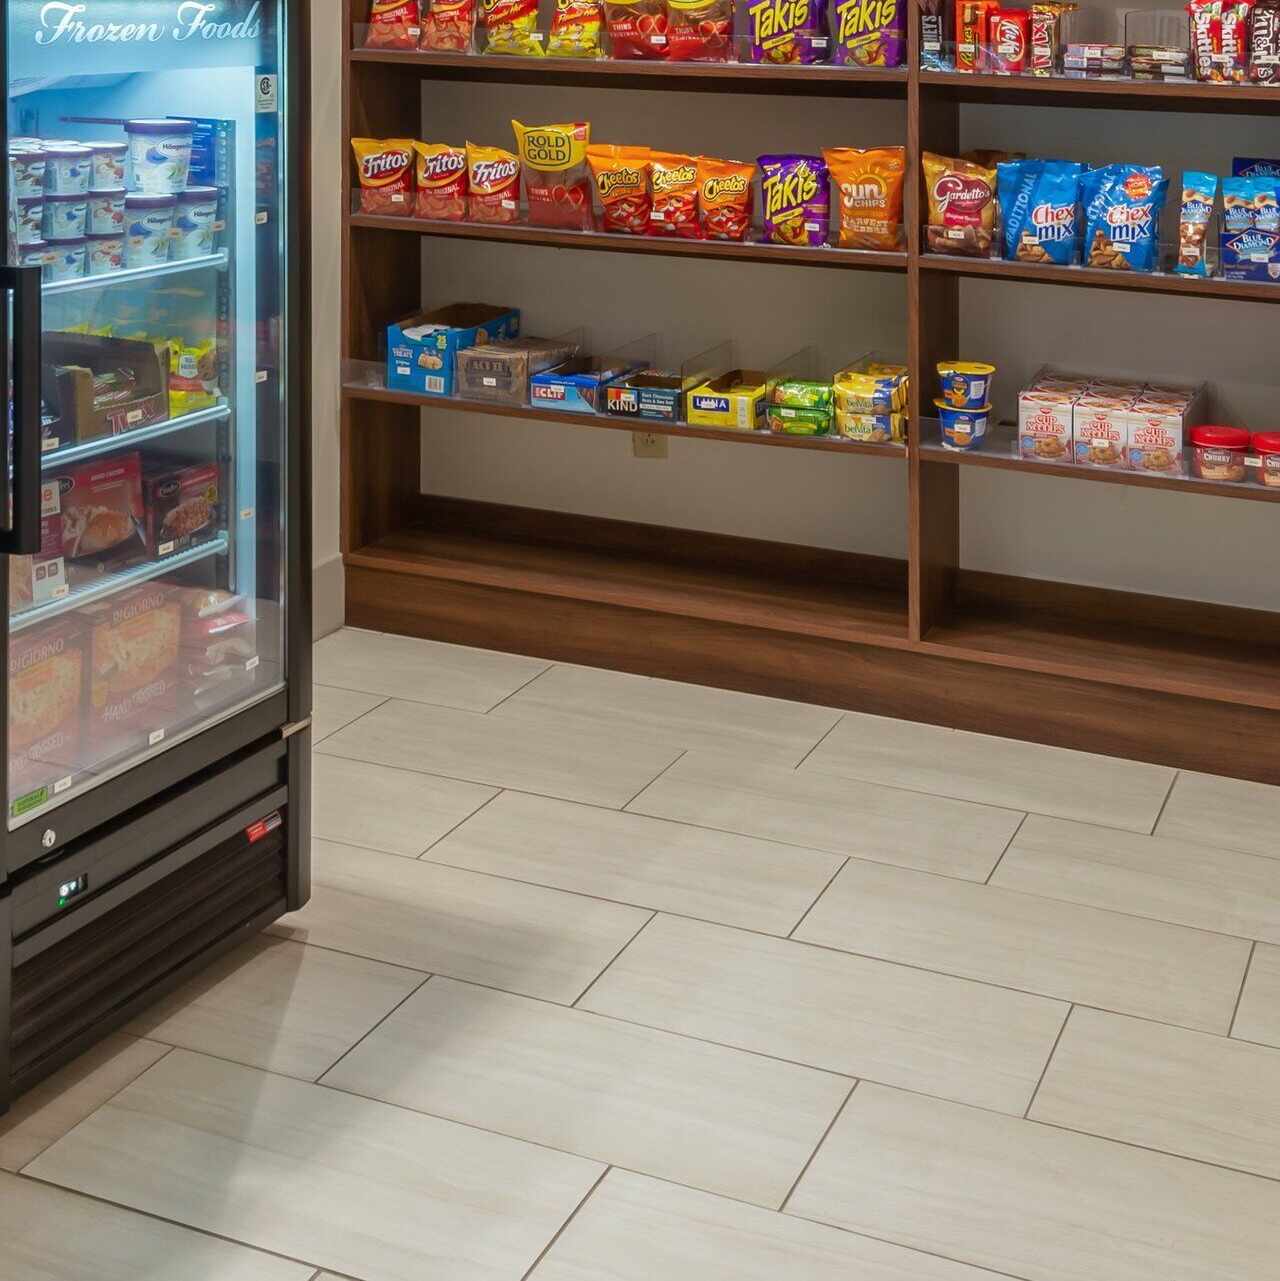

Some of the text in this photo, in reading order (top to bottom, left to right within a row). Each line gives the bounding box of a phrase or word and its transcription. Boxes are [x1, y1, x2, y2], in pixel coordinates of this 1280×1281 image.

[35, 1, 261, 46] Frozen Foods
[1194, 12, 1211, 78] Skittles
[1221, 12, 1237, 78] Skittles
[527, 135, 565, 148] ROLD
[363, 154, 409, 178] Fritos
[424, 155, 464, 178] Fritos
[527, 149, 570, 164] GOLD
[473, 162, 516, 183] Fritos
[598, 170, 638, 195] Cheetos
[652, 165, 695, 191] Cheetos
[704, 177, 748, 201] Cheetos
[763, 172, 817, 220] Takis
[841, 185, 880, 208] Sun
[934, 176, 990, 214] Gardetto's
[1032, 203, 1073, 223] Chex
[1109, 203, 1151, 224] Chex
[1038, 222, 1074, 242] mix
[1112, 223, 1149, 241] mix
[1242, 233, 1264, 244] BLUE
[1233, 237, 1274, 251] DIAMOND
[539, 389, 564, 399] CLIF
[608, 399, 638, 412] KIND
[1035, 416, 1056, 427] CUP
[1090, 422, 1112, 433] CUP
[1144, 428, 1166, 439] CUP
